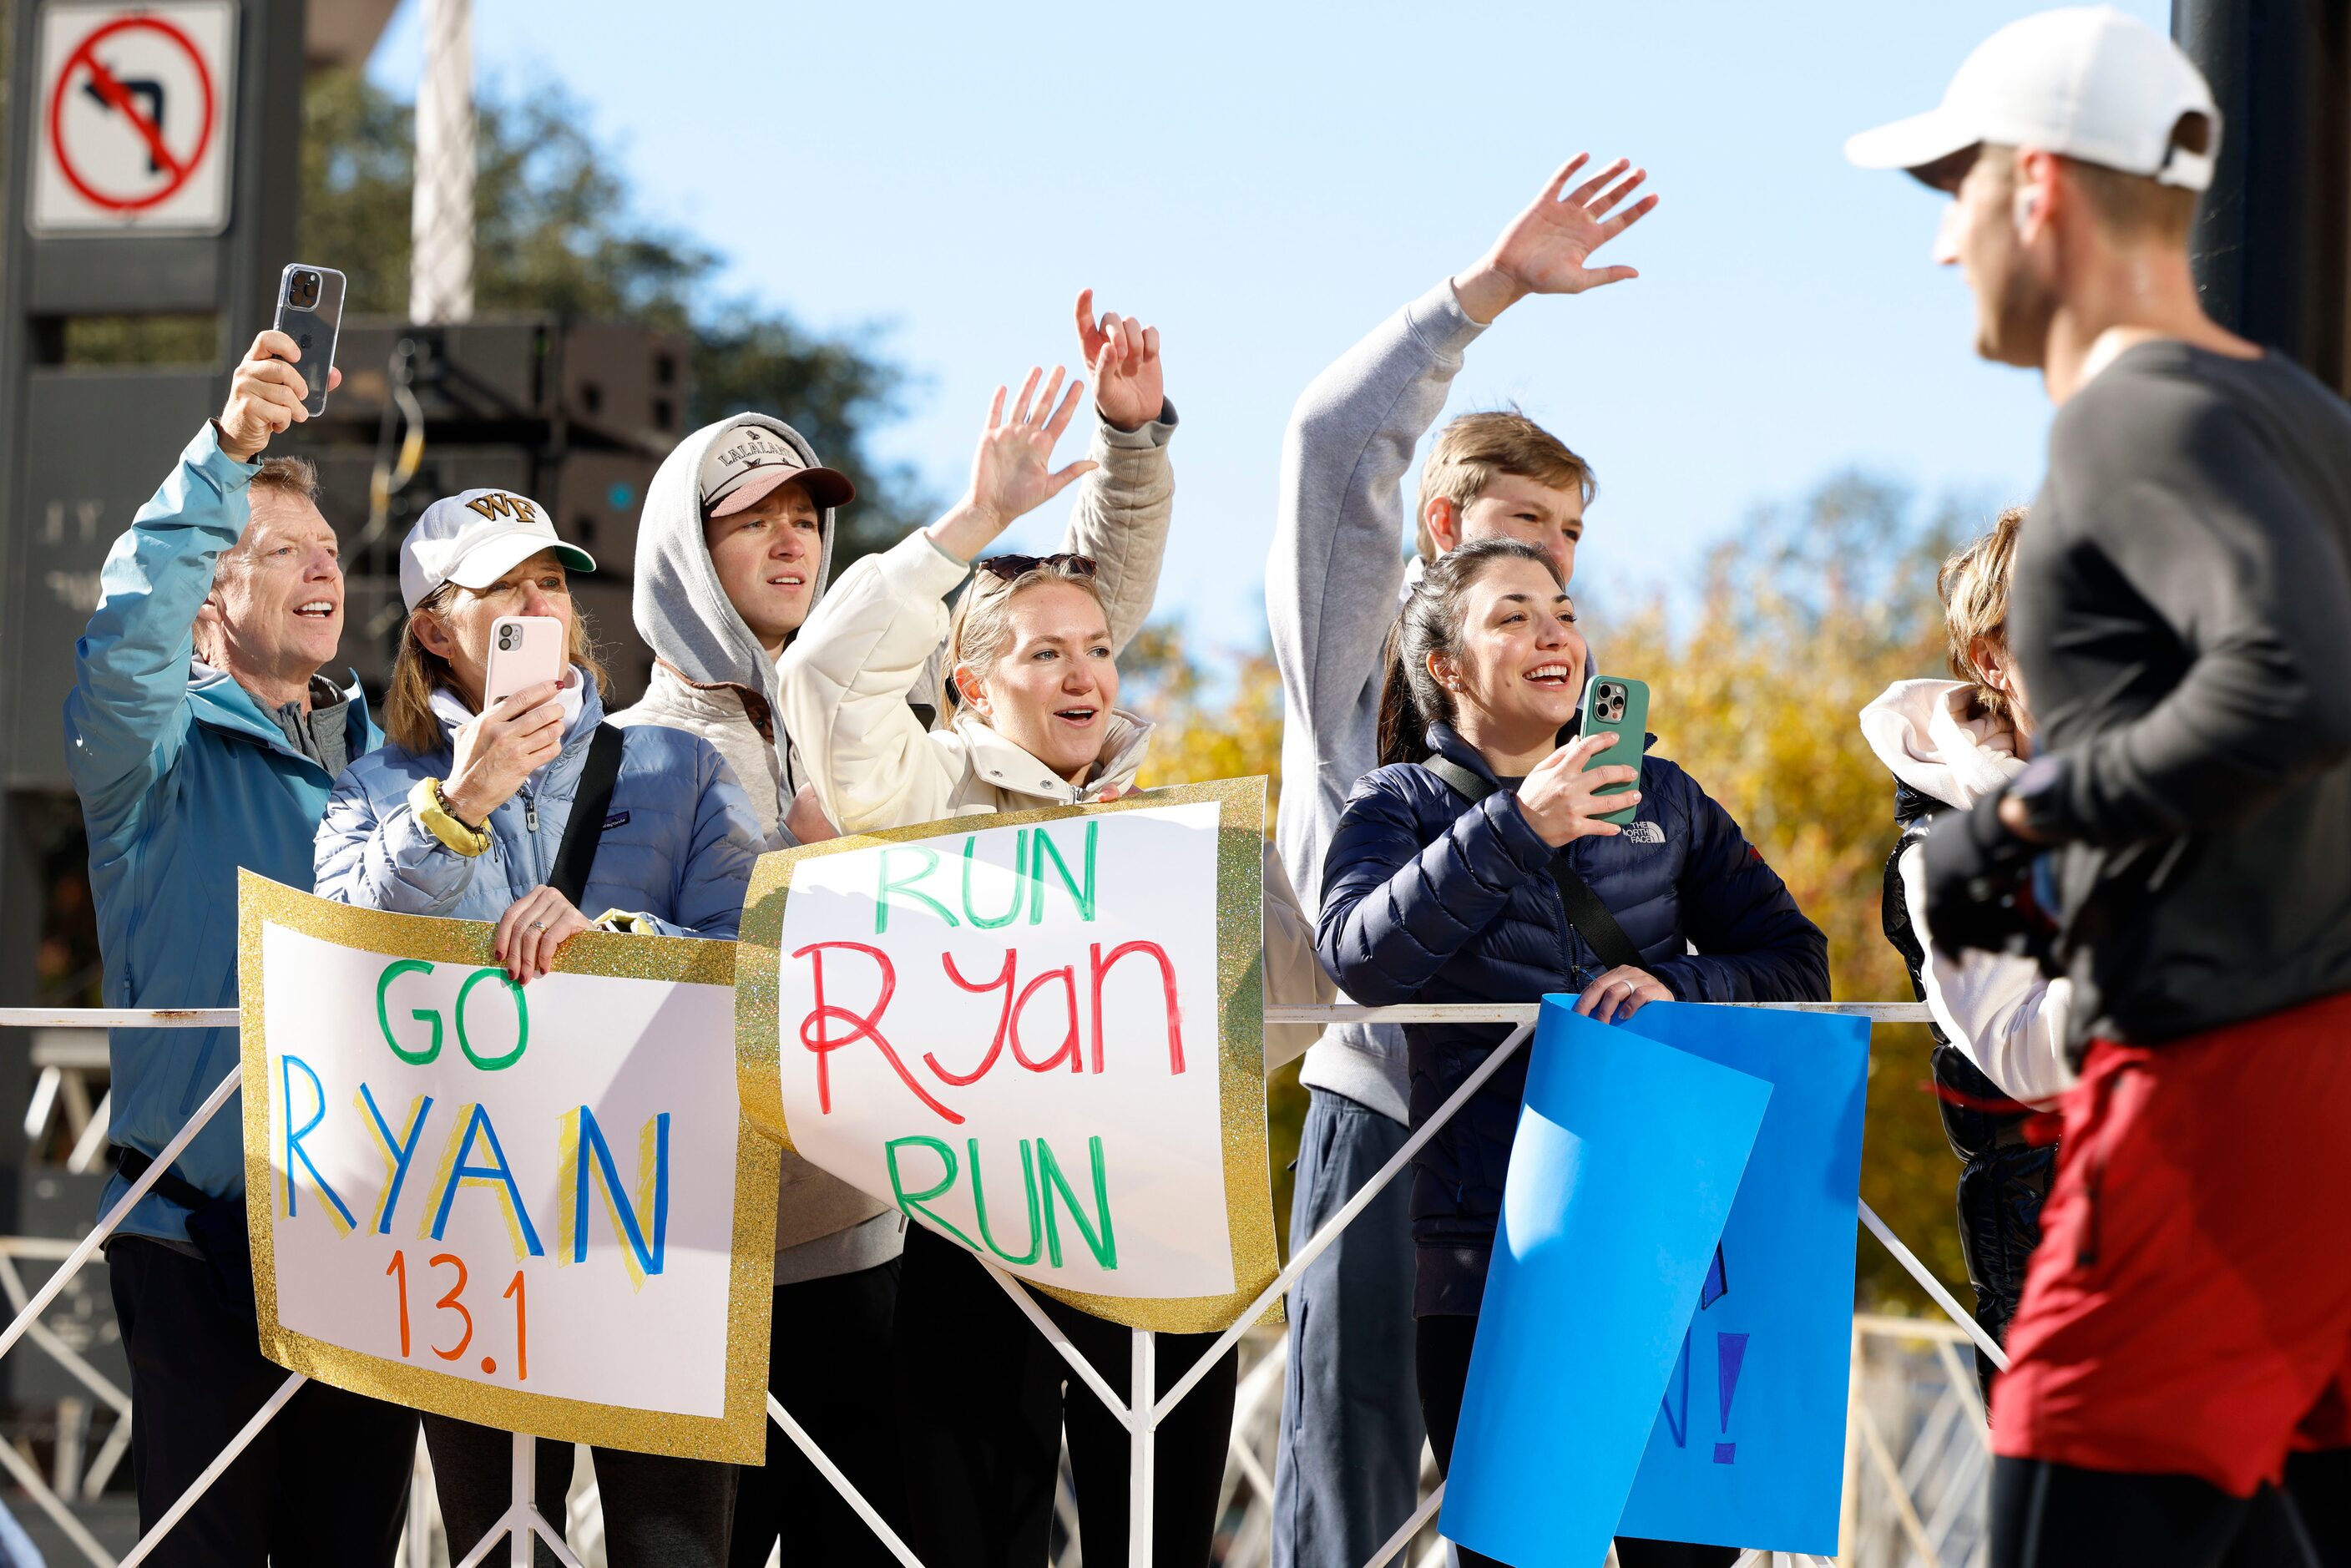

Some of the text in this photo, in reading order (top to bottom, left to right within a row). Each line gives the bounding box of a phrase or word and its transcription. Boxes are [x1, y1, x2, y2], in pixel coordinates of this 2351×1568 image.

[466, 493, 536, 523] WF
[874, 820, 1099, 935] RUN
[1622, 828, 1650, 837] NORTH
[377, 959, 529, 1071] GO
[791, 940, 1186, 1125] Ryan
[275, 1055, 670, 1290] RYAN
[885, 1135, 1118, 1271] RUN
[386, 1250, 528, 1382] 13.1
